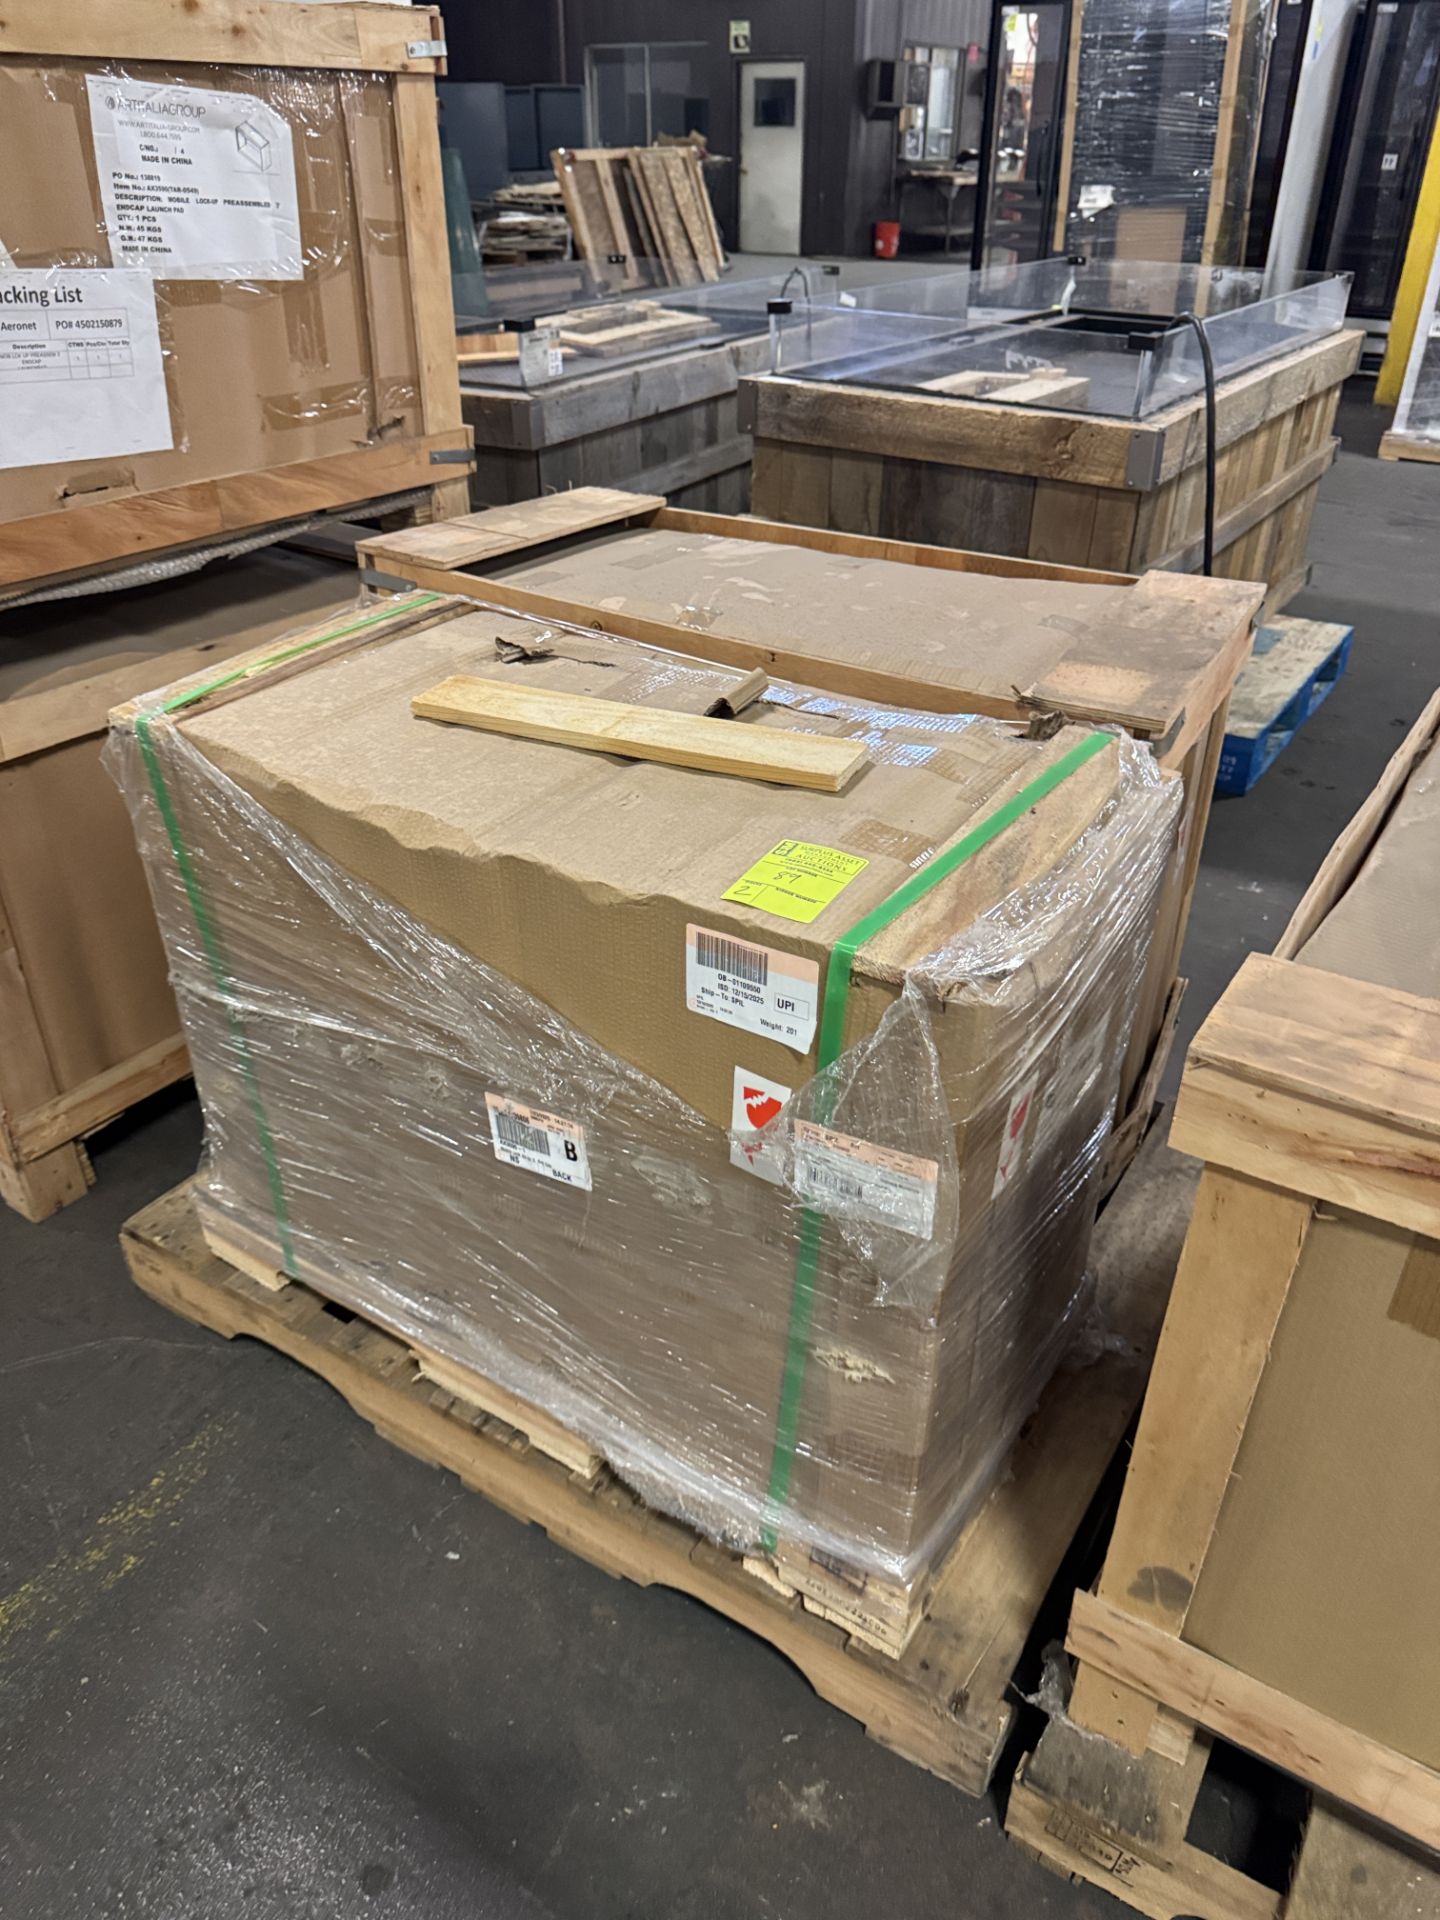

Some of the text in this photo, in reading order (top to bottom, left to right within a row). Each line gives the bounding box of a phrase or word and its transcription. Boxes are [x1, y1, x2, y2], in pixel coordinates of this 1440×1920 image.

[141, 154, 193, 166] MADE IN CHINA
[112, 172, 123, 180] PO
[113, 183, 131, 191] Item
[167, 196, 190, 204] MOBILE
[116, 204, 145, 212] ENDCAP
[136, 215, 141, 223] 1
[142, 215, 157, 223] PCS
[136, 225, 145, 233] 45
[146, 226, 162, 234] KGS
[137, 235, 147, 243] 47
[147, 236, 163, 244] KGS
[122, 245, 140, 253] MADE
[150, 246, 172, 254] CHINA
[0, 285, 84, 308] cking List
[1, 318, 123, 331] Aeronet PO# 4502150879
[12, 343, 47, 351] Description
[733, 885, 751, 896] 2
[731, 996, 745, 1008] SPIL
[777, 998, 795, 1012] UPI
[760, 1018, 797, 1036] Weight: 201
[564, 1140, 578, 1162] B
[552, 1169, 572, 1182] BACK
